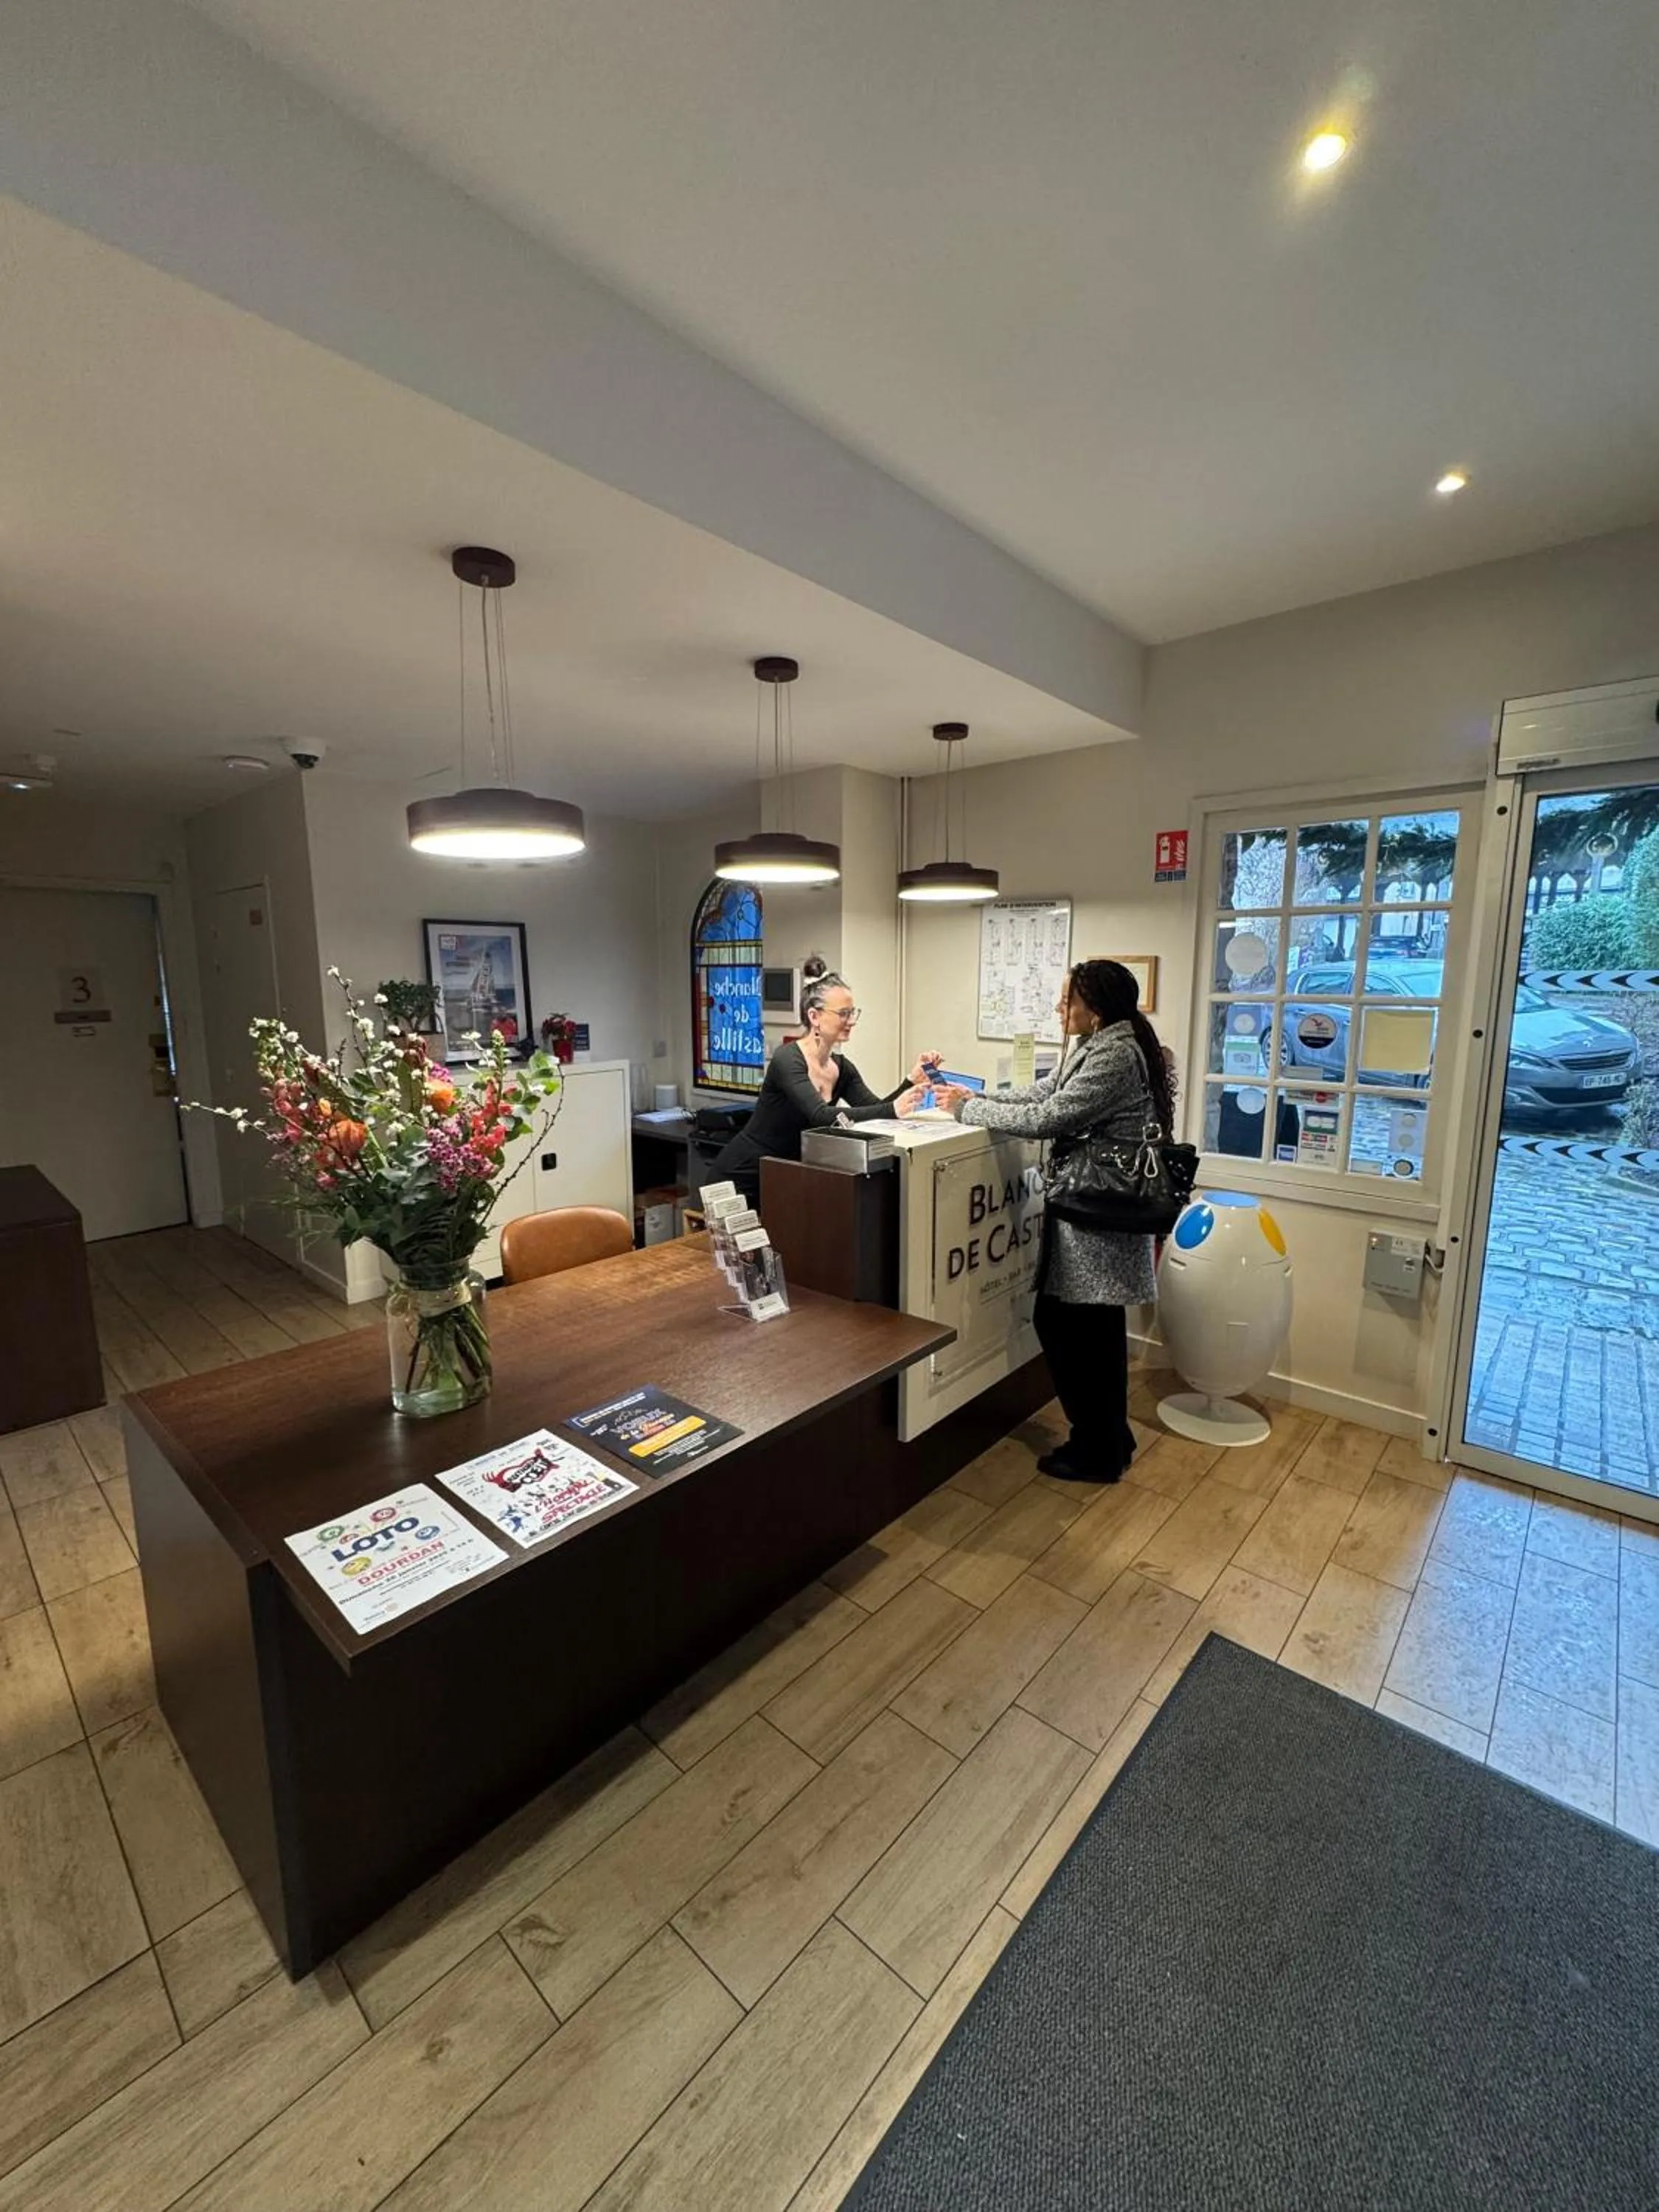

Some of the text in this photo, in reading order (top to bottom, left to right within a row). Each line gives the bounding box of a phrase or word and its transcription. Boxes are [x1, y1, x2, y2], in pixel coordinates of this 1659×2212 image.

[72, 976, 91, 1004] 3
[969, 1172, 1044, 1225] BLANC
[947, 1212, 1044, 1279] DE CAST
[331, 1517, 420, 1562] LOTO
[358, 1540, 445, 1585] DOURDAN
